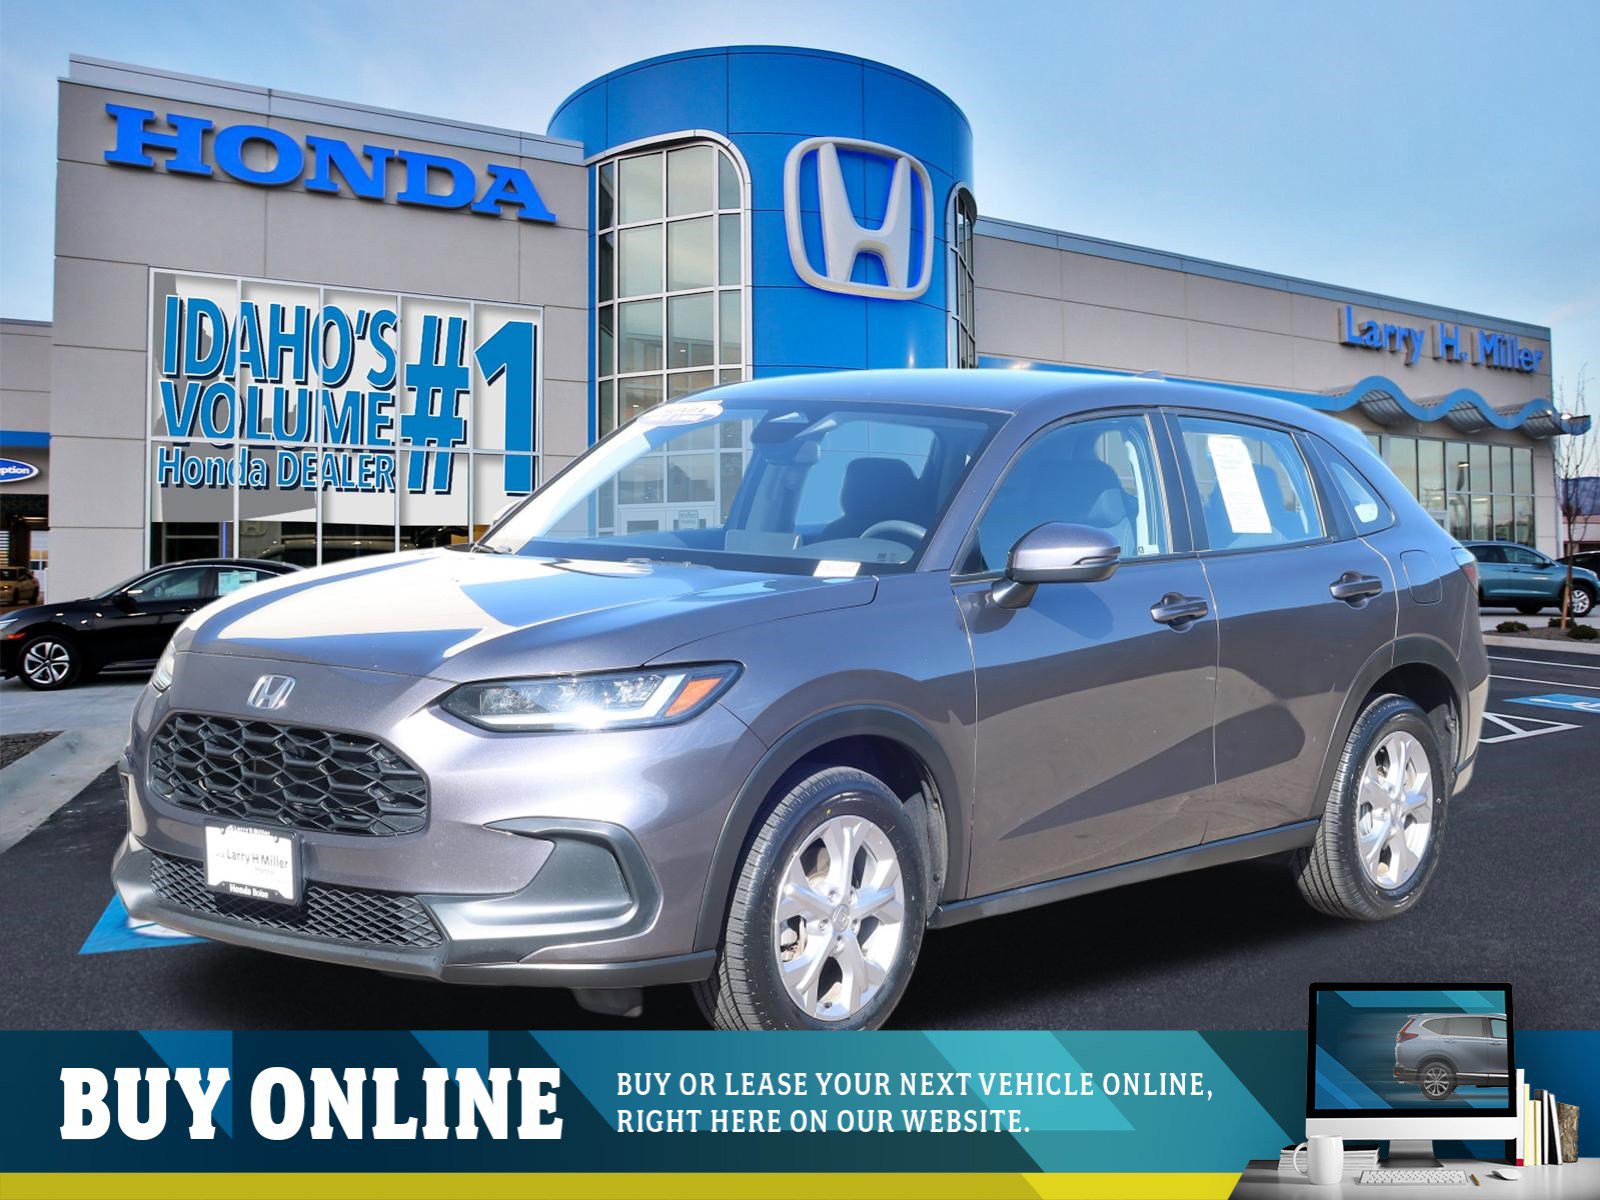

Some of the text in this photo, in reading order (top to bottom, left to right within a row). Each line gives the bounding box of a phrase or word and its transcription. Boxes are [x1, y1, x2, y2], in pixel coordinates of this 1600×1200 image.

[104, 103, 557, 224] HONDA
[162, 294, 398, 391] IDAHO'S
[1342, 304, 1545, 372] Larry H. Miller
[159, 379, 397, 448] VOLUME
[400, 314, 536, 495] #1
[157, 445, 397, 491] Honda DEALER
[226, 848, 288, 869] Larry H Miller
